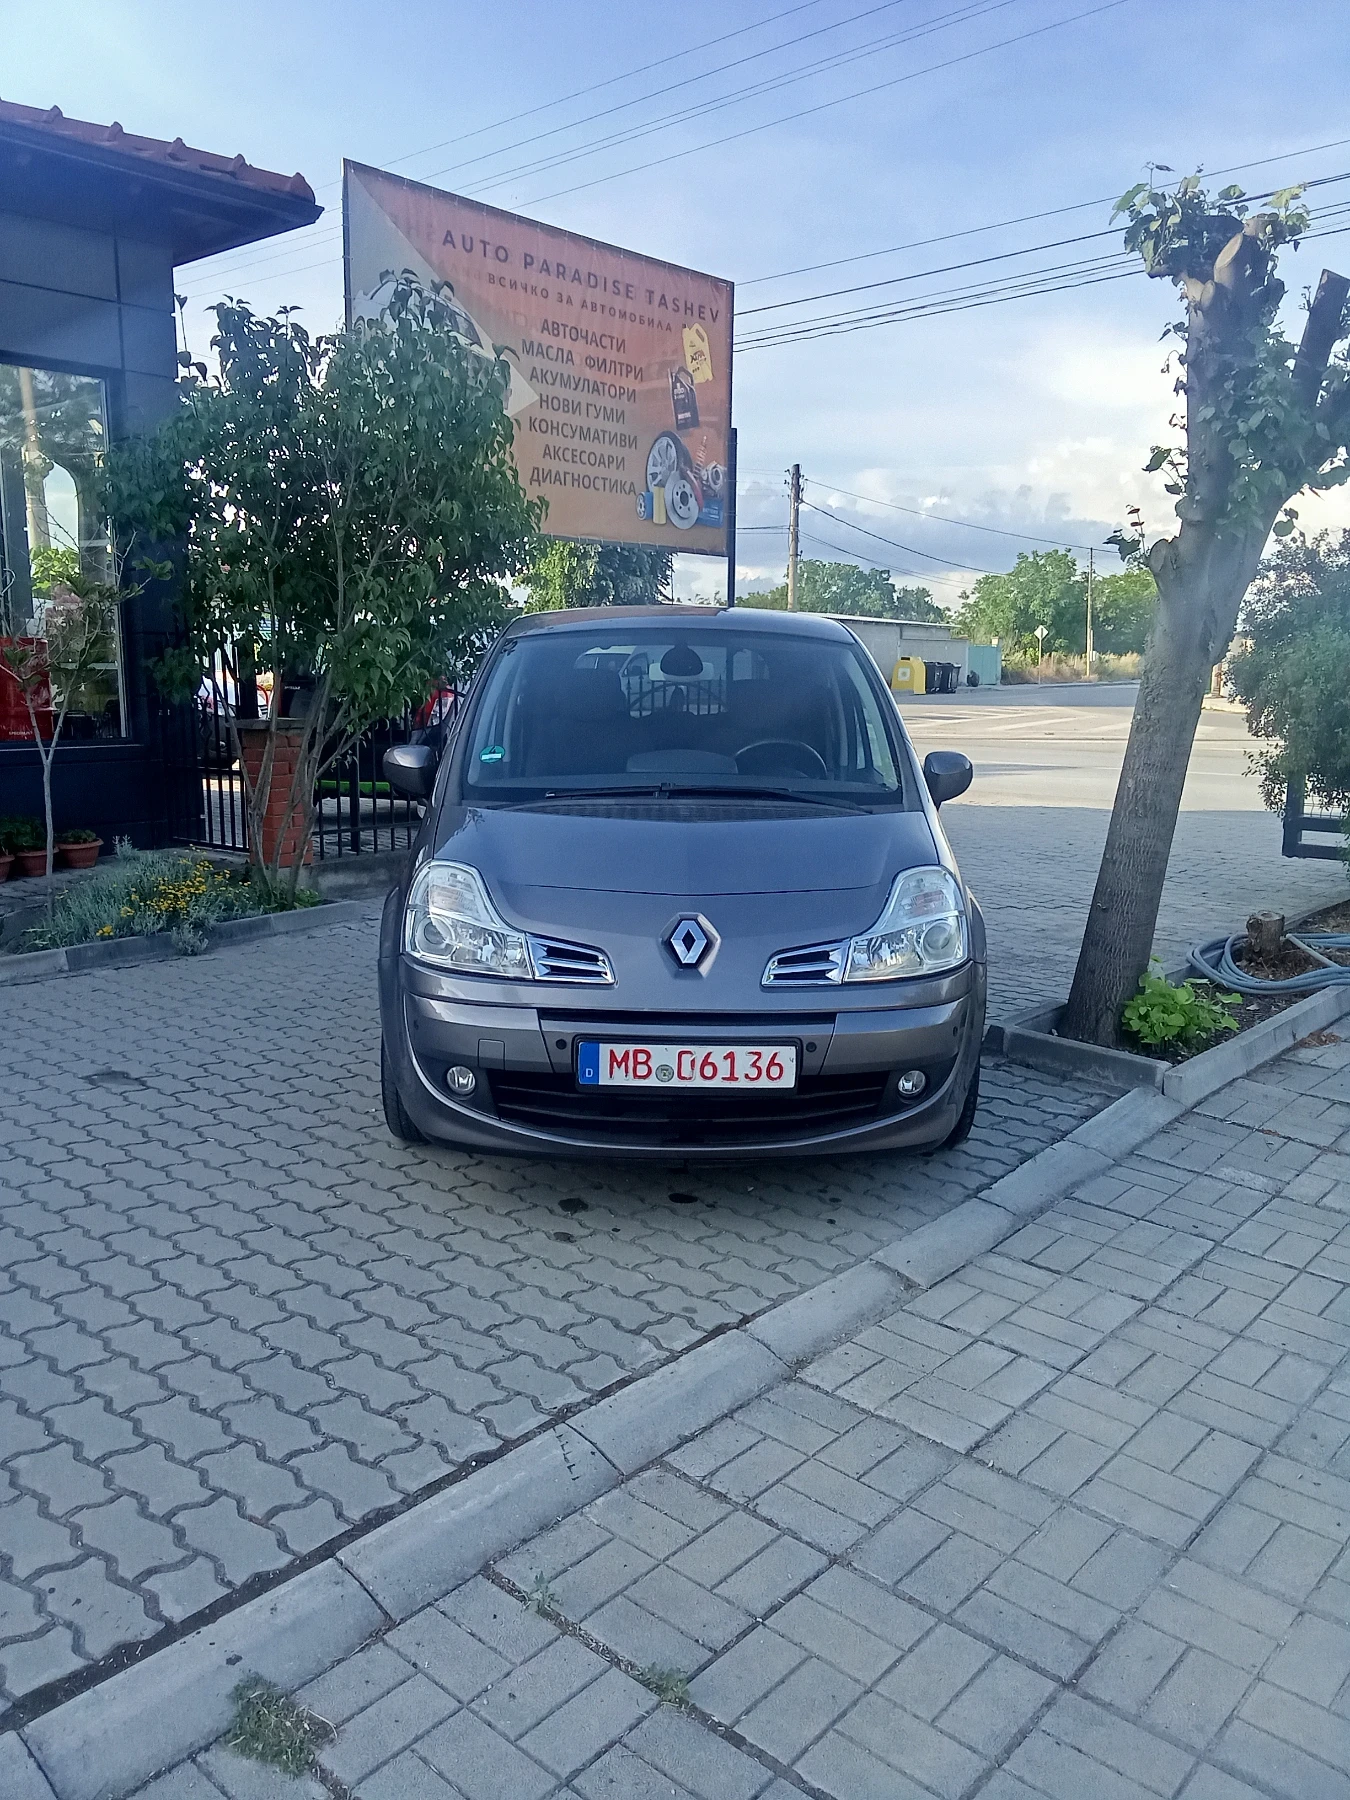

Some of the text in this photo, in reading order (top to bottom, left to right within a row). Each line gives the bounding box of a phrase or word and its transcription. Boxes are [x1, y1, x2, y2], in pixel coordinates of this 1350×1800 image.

[442, 229, 510, 264] AUTO
[523, 252, 634, 300] PARADISE
[645, 287, 720, 324] TASHEV
[488, 272, 673, 333] ВСИЧКО ЗА АВТОМОБИЛА
[540, 318, 626, 354] АВТОЧАСТИ
[522, 338, 644, 383] МАСЛА ФИЛТРИ
[529, 366, 637, 404] АКУМУЛАТОРИ
[539, 393, 626, 425] НОВИ ГУМИ
[528, 416, 638, 450] КОНСУМАТИВИ
[542, 443, 626, 472] АКСЕСОАРИ
[529, 466, 637, 497] ДИАГНОСТИКА
[585, 1068, 593, 1078] D
[609, 1049, 653, 1080] MB
[676, 1050, 785, 1082] 06136
